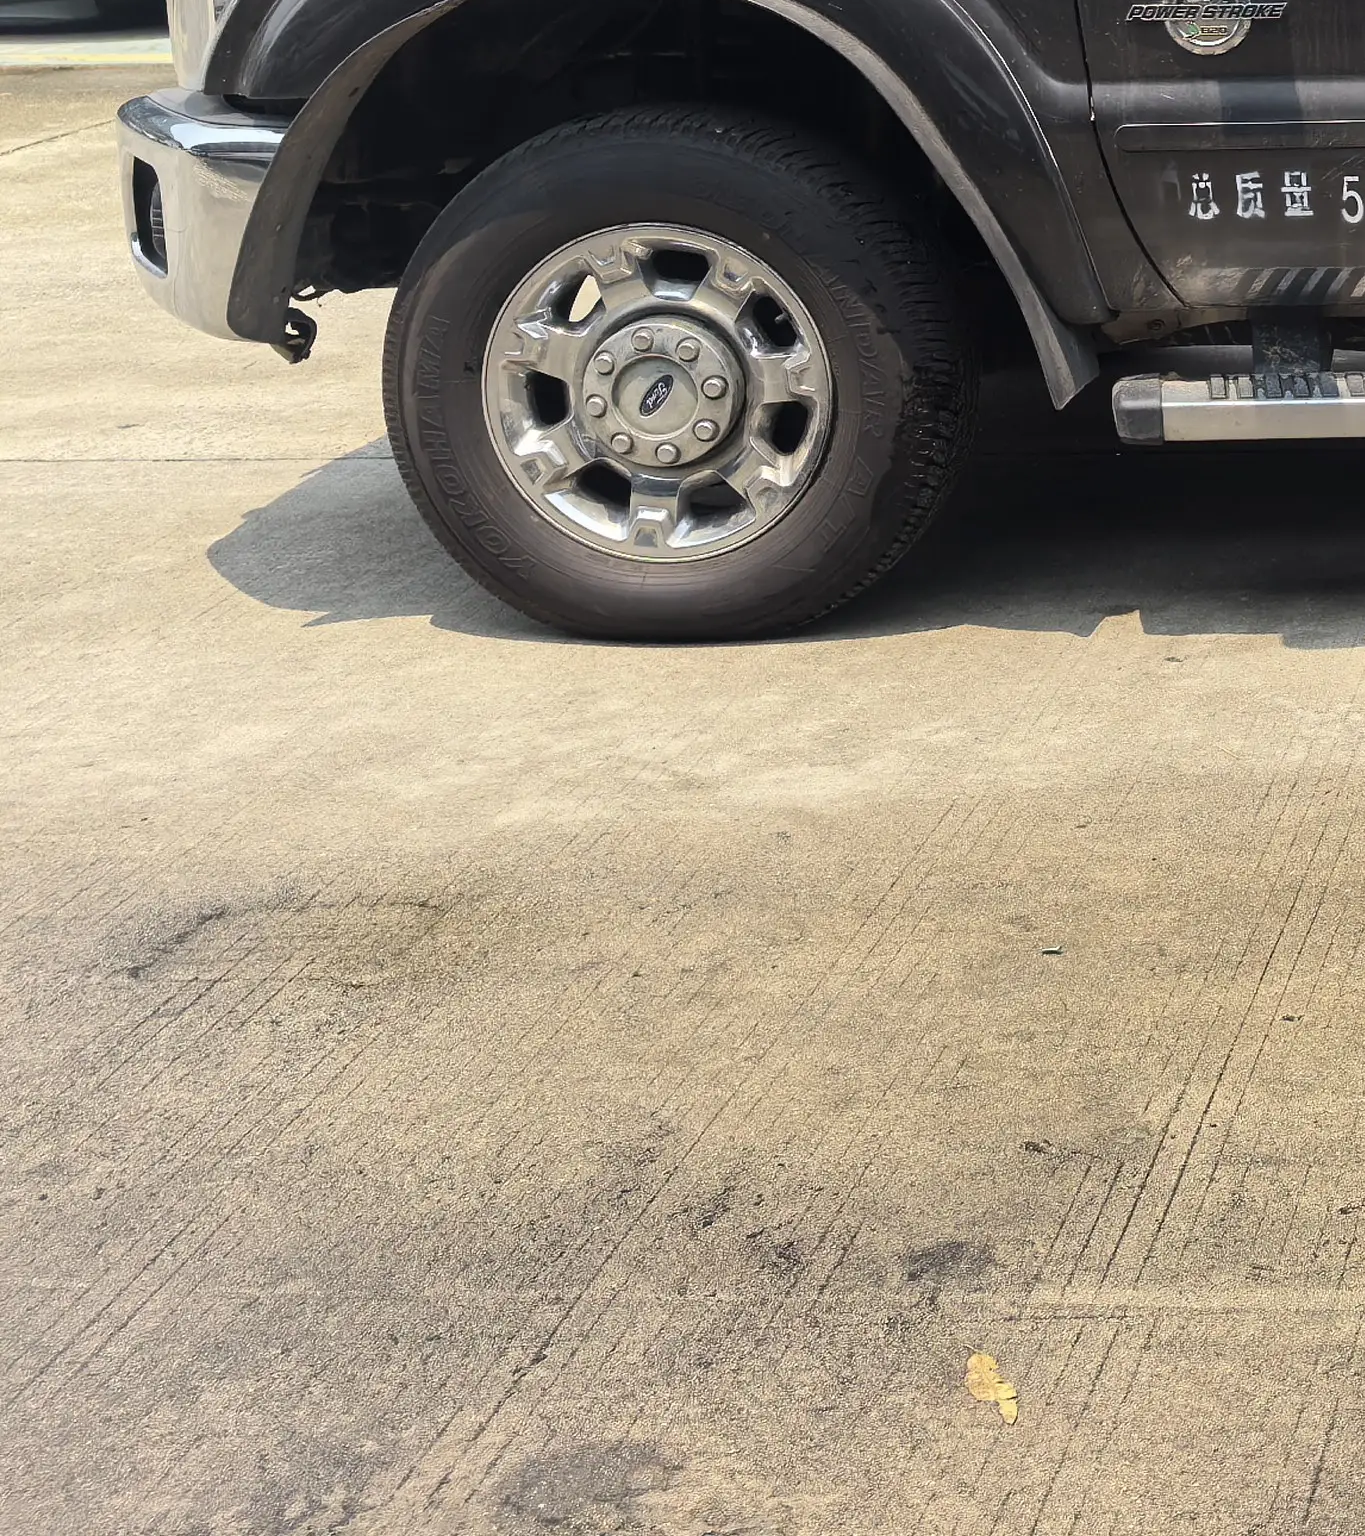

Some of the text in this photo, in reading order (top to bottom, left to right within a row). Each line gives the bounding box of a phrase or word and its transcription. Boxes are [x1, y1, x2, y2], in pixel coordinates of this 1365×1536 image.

[1126, 1, 1288, 21] POWER STROKE
[1188, 171, 1315, 219] 总质量
